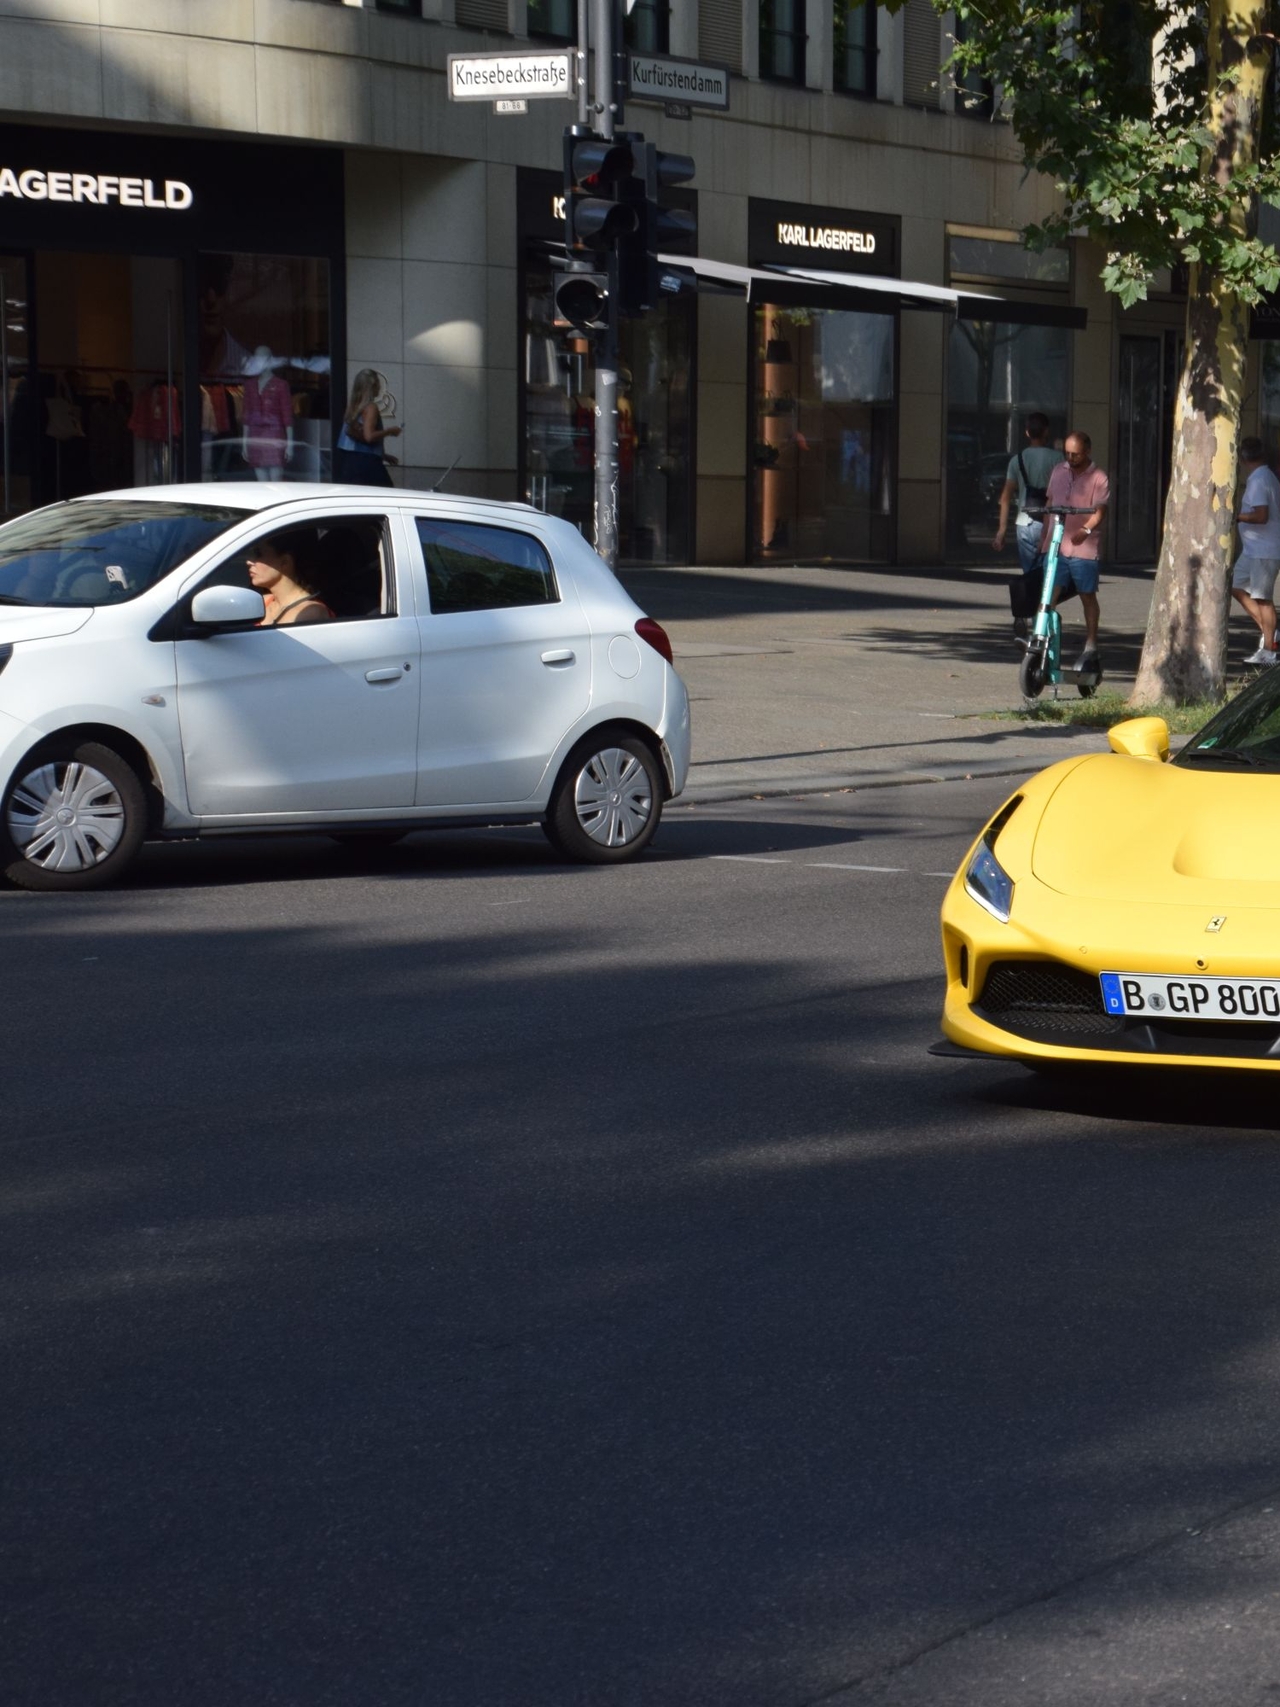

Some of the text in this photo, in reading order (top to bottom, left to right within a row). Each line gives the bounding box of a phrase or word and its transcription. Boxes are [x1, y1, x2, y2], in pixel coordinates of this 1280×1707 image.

[456, 62, 566, 87] Knesebeckstraße
[633, 61, 723, 95] Kurfürstendamm
[0, 168, 193, 210] AGERFELD
[778, 223, 876, 254] KARL LAGERFELD
[1123, 980, 1145, 1010] B
[1167, 982, 1208, 1013] GP
